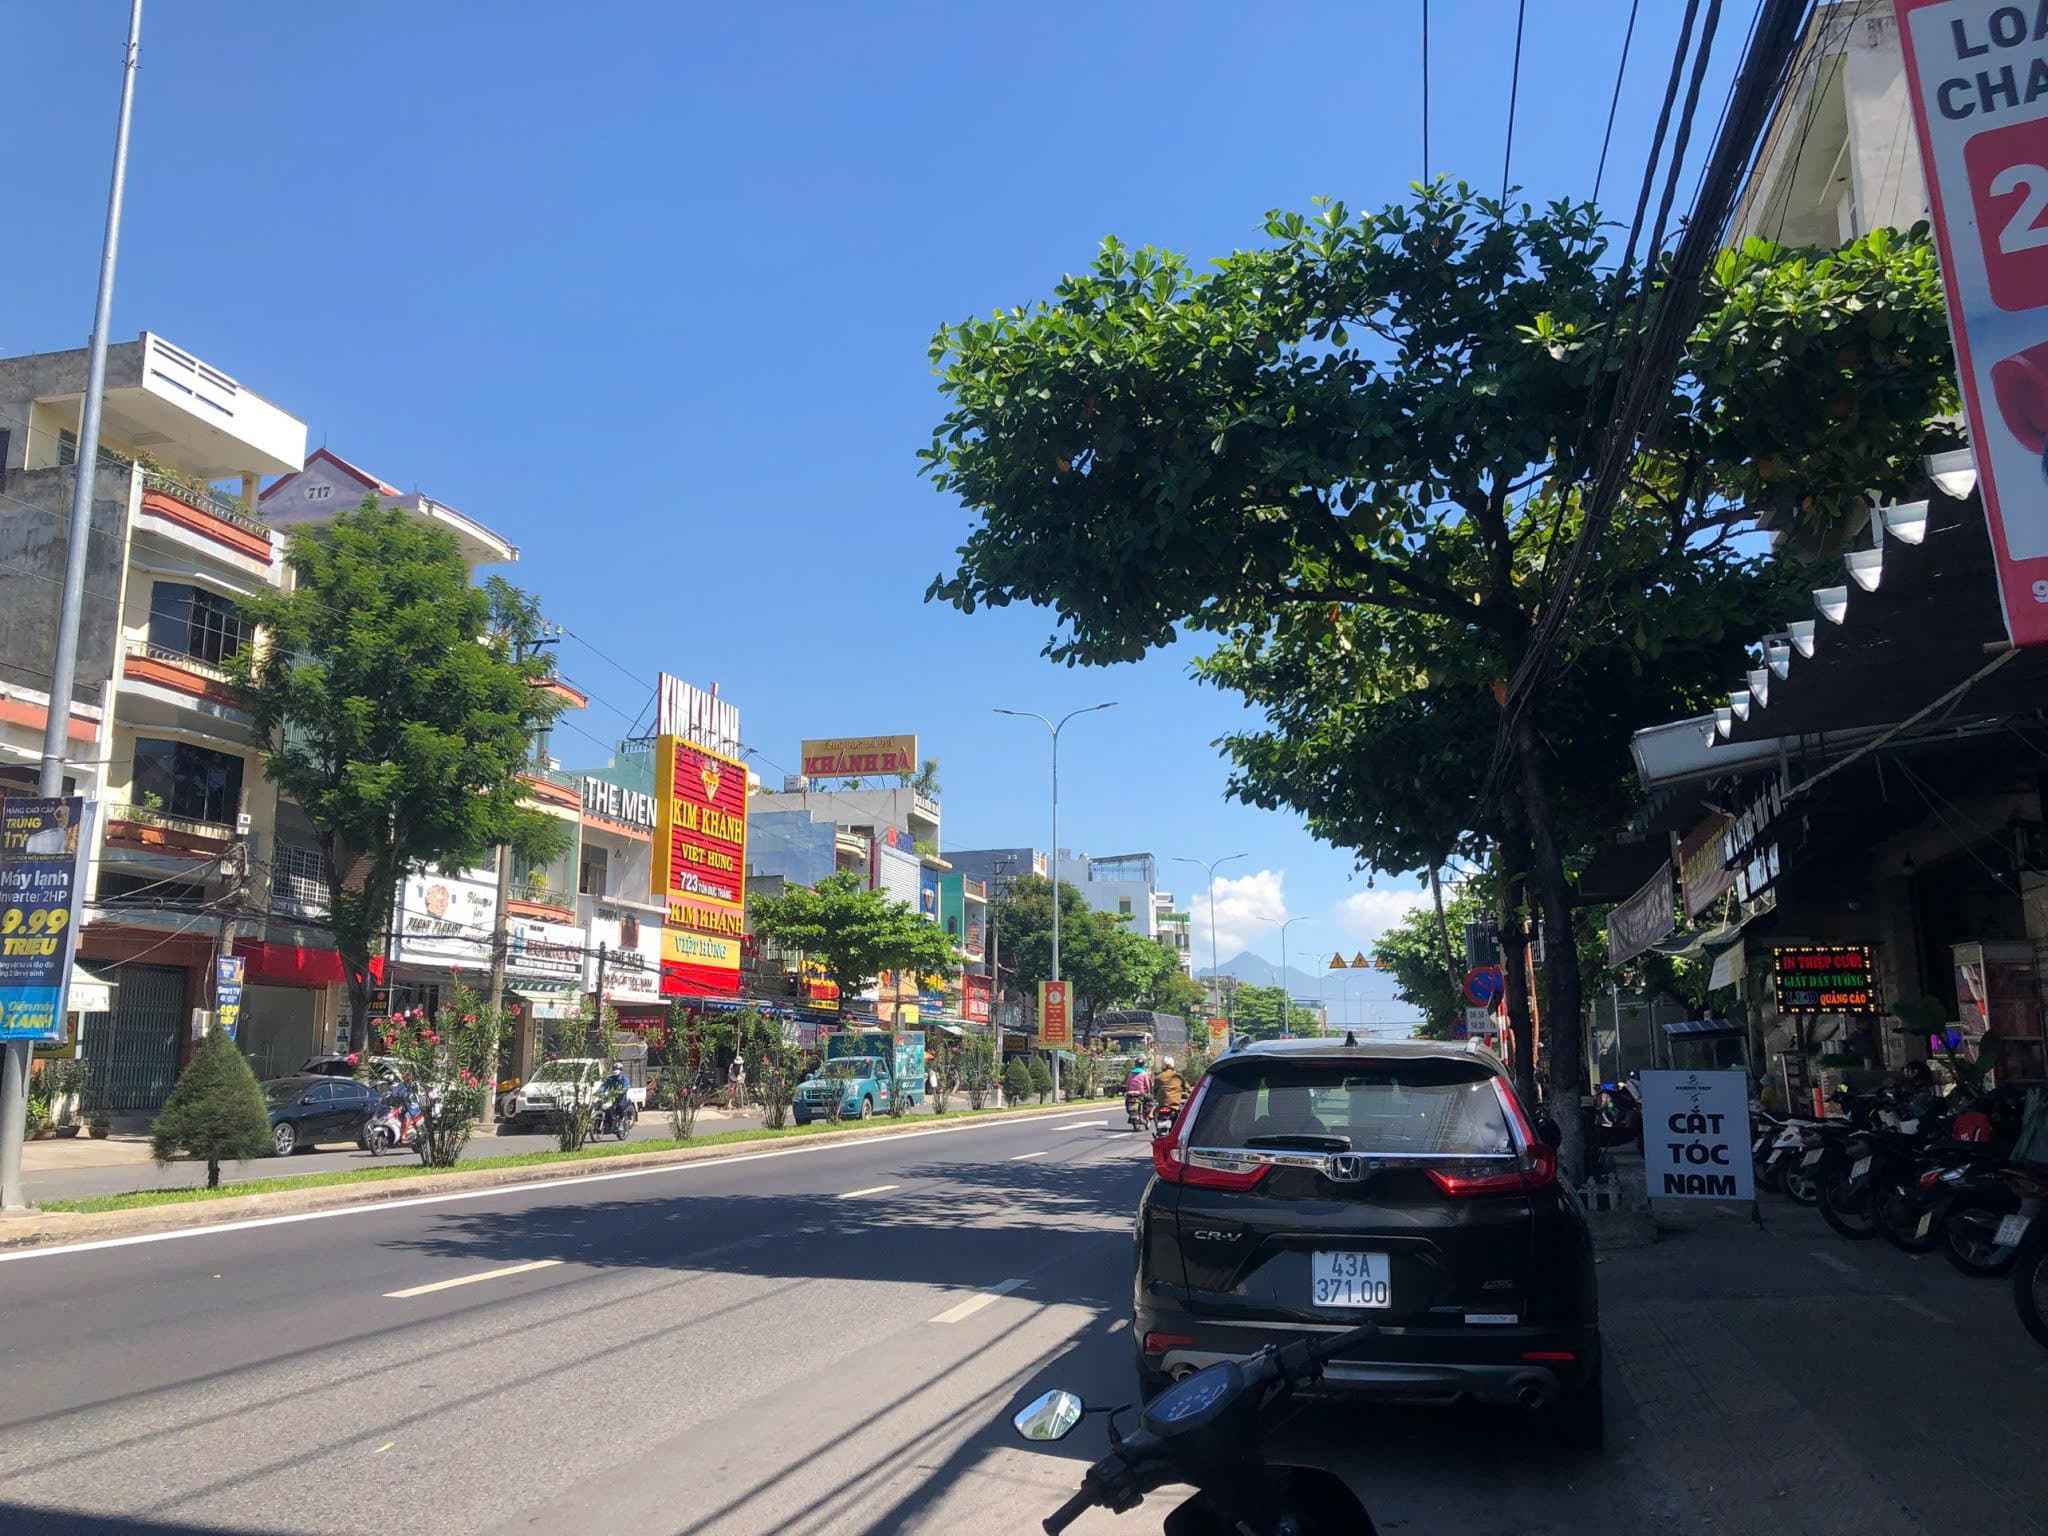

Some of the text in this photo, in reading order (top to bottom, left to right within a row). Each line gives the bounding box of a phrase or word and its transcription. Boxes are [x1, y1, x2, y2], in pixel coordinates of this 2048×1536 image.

[309, 486, 331, 499] 717
[659, 671, 691, 740] KIM
[804, 746, 911, 775] KHÁNH HÀ
[583, 776, 658, 828] THE MEN
[672, 798, 743, 845] KIM KHÁNH
[681, 841, 734, 871] VIỆT HÙNG
[1, 869, 69, 890] Máy lạnh
[680, 871, 698, 892] 723
[0, 889, 67, 903] Inverter 2HP
[0, 908, 69, 935] 9.99
[670, 902, 744, 936] KIM KHÁNH
[3, 933, 58, 959] TRIỆU
[675, 934, 727, 960] VIỆT HÙNG
[1783, 956, 1795, 969] IN
[1819, 990, 1849, 1006] QUẢNG
[1849, 991, 1867, 1004] CÁO
[4, 1013, 53, 1029] XANH
[1668, 1105, 1725, 1135] CẮT
[1667, 1139, 1730, 1165] TÓC
[1664, 1173, 1737, 1196] NAM
[1194, 1230, 1243, 1242] CR-V
[1331, 1252, 1371, 1278] 43A
[1316, 1278, 1387, 1304] 371.00
